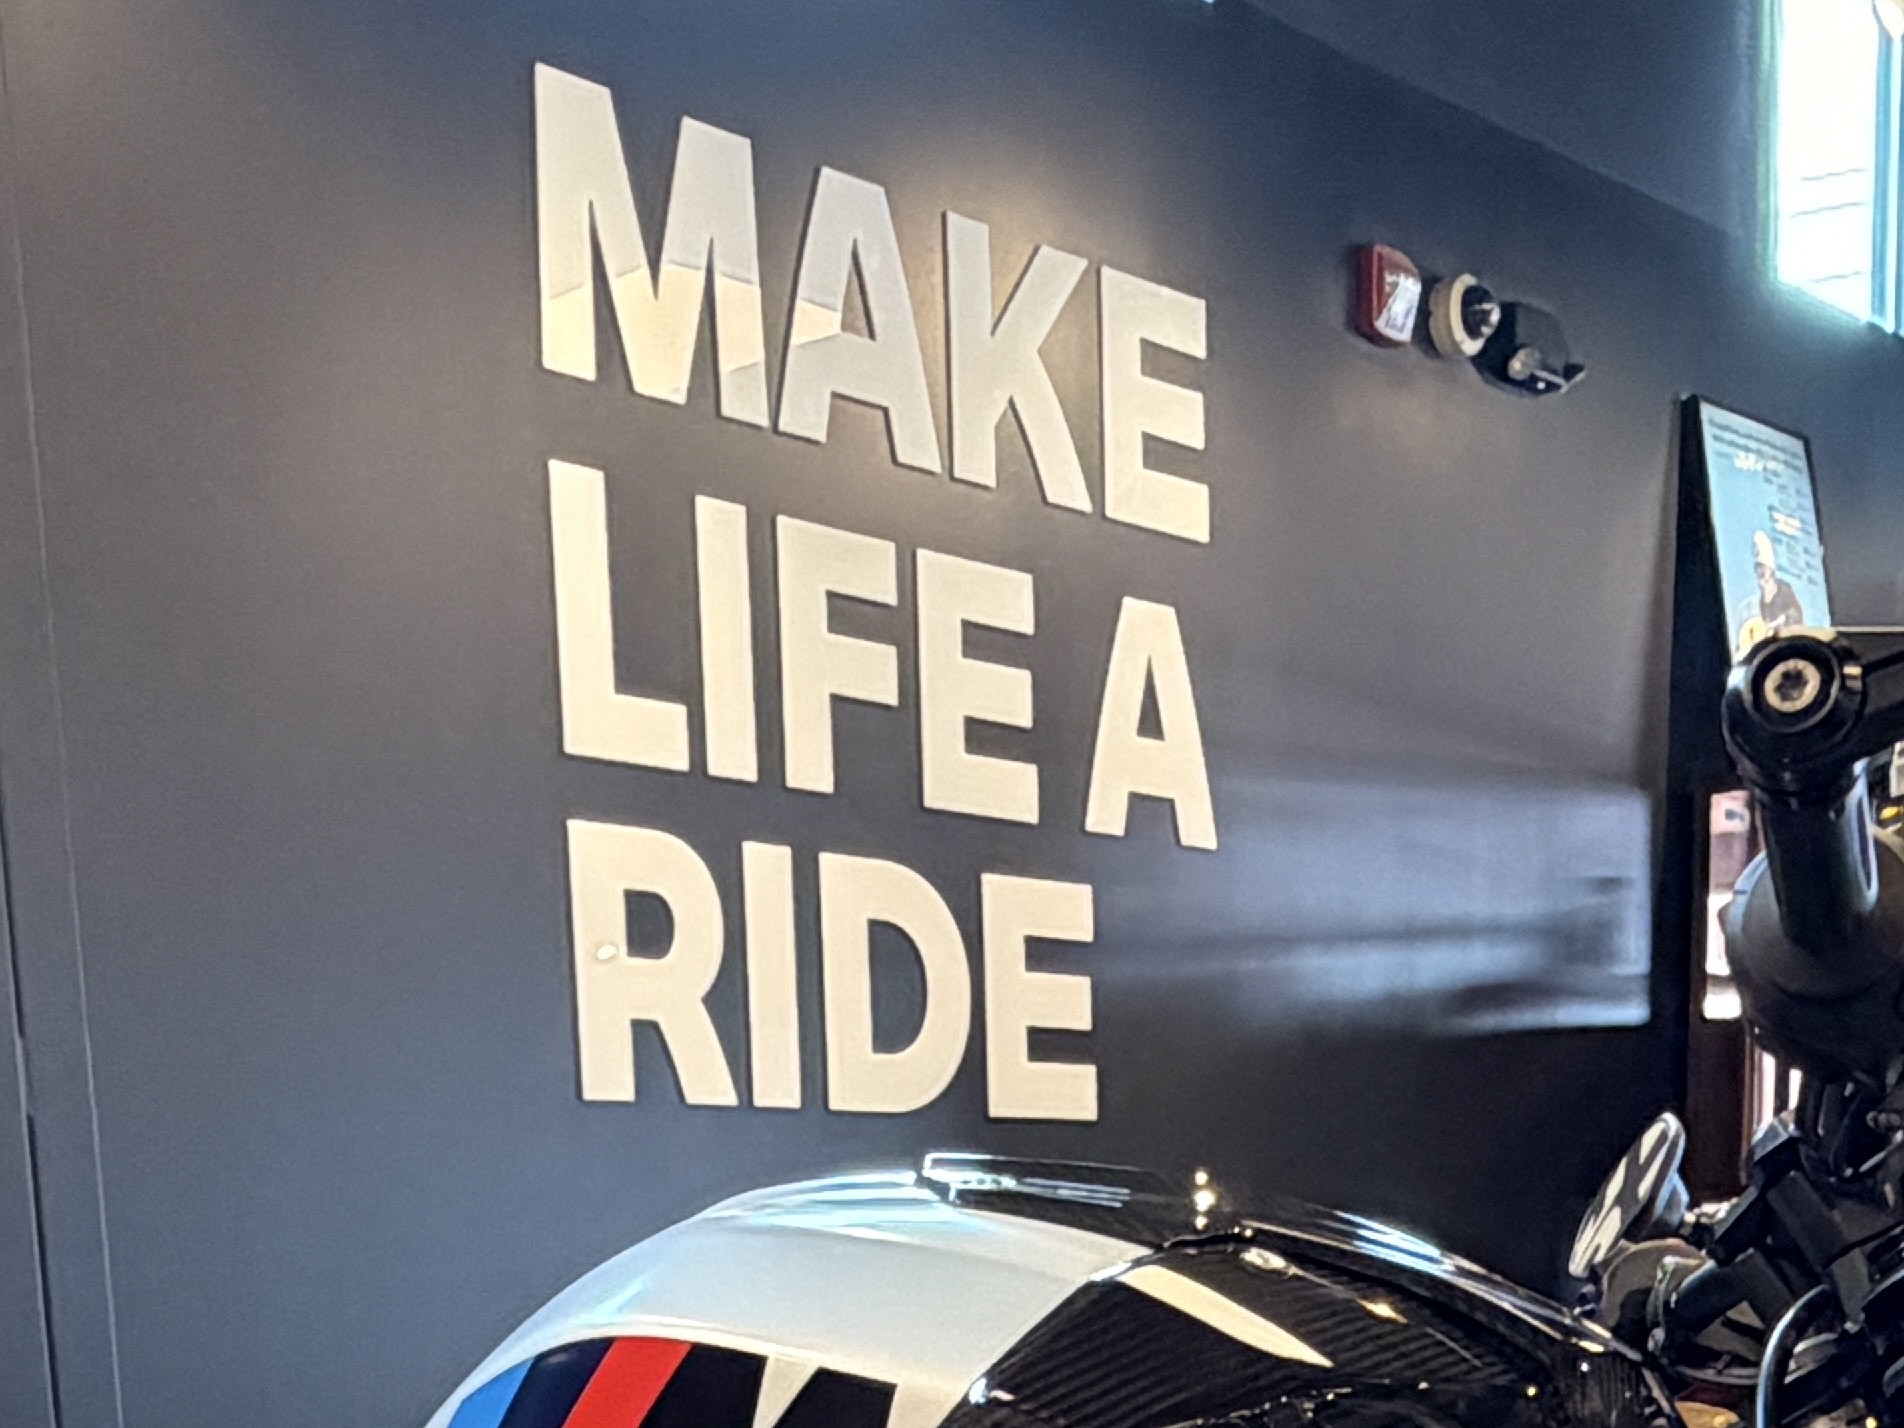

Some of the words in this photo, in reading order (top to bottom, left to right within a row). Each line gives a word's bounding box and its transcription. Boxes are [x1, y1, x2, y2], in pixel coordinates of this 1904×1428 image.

[534, 61, 1211, 543] MAKE
[547, 458, 1039, 825] LIFE
[1085, 595, 1217, 850] A
[566, 818, 1097, 1121] RIDE
